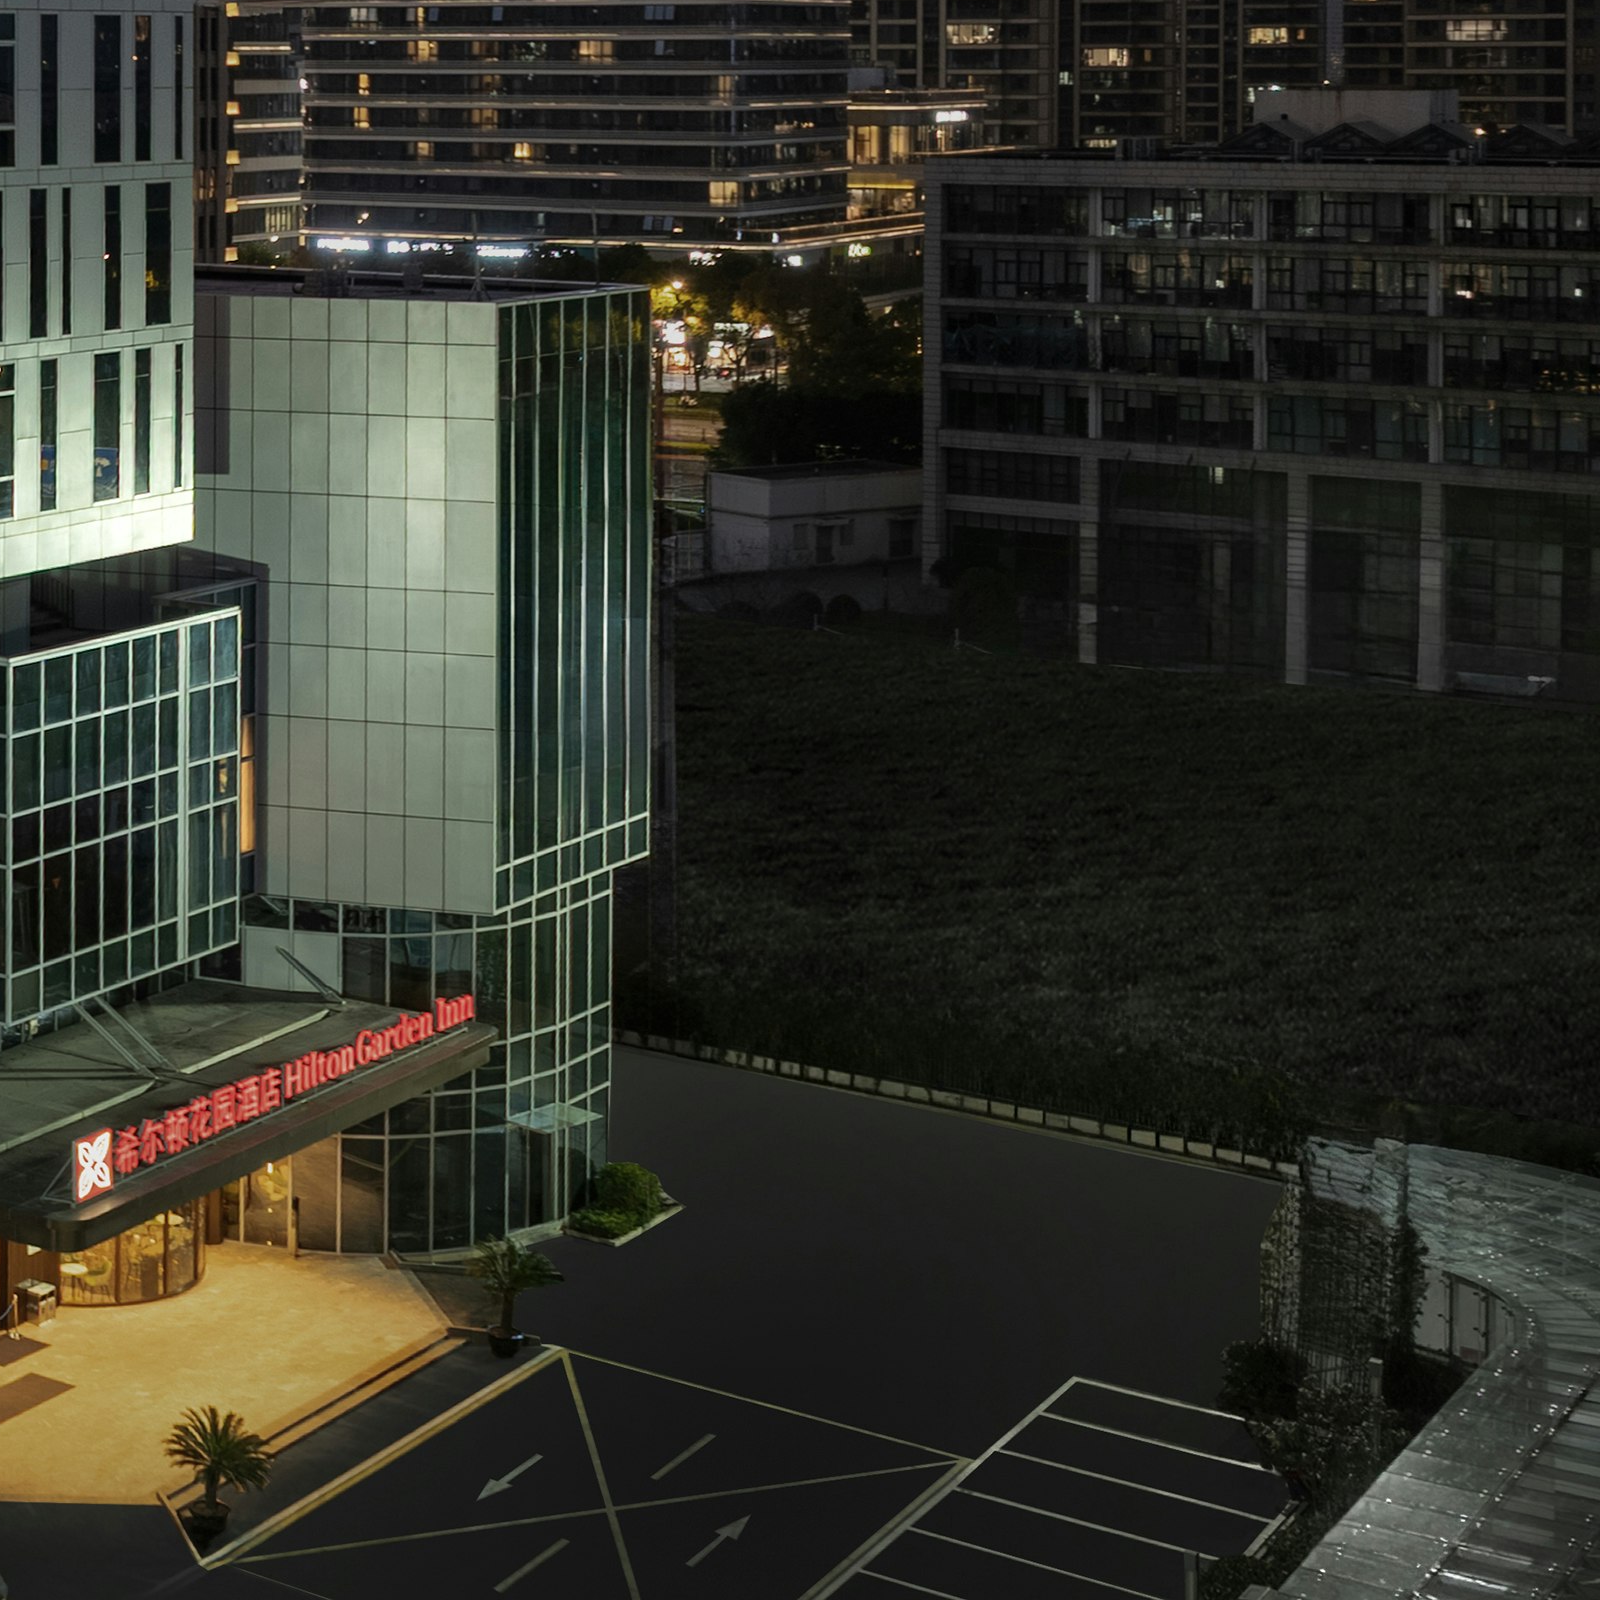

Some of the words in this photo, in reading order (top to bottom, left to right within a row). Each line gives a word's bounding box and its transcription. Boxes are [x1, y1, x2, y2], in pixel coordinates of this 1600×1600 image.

[114, 1067, 282, 1173] 希尔顿花园酒店
[284, 1045, 356, 1099] Hilton
[356, 1012, 435, 1066] Garden
[435, 994, 475, 1032] Inn
